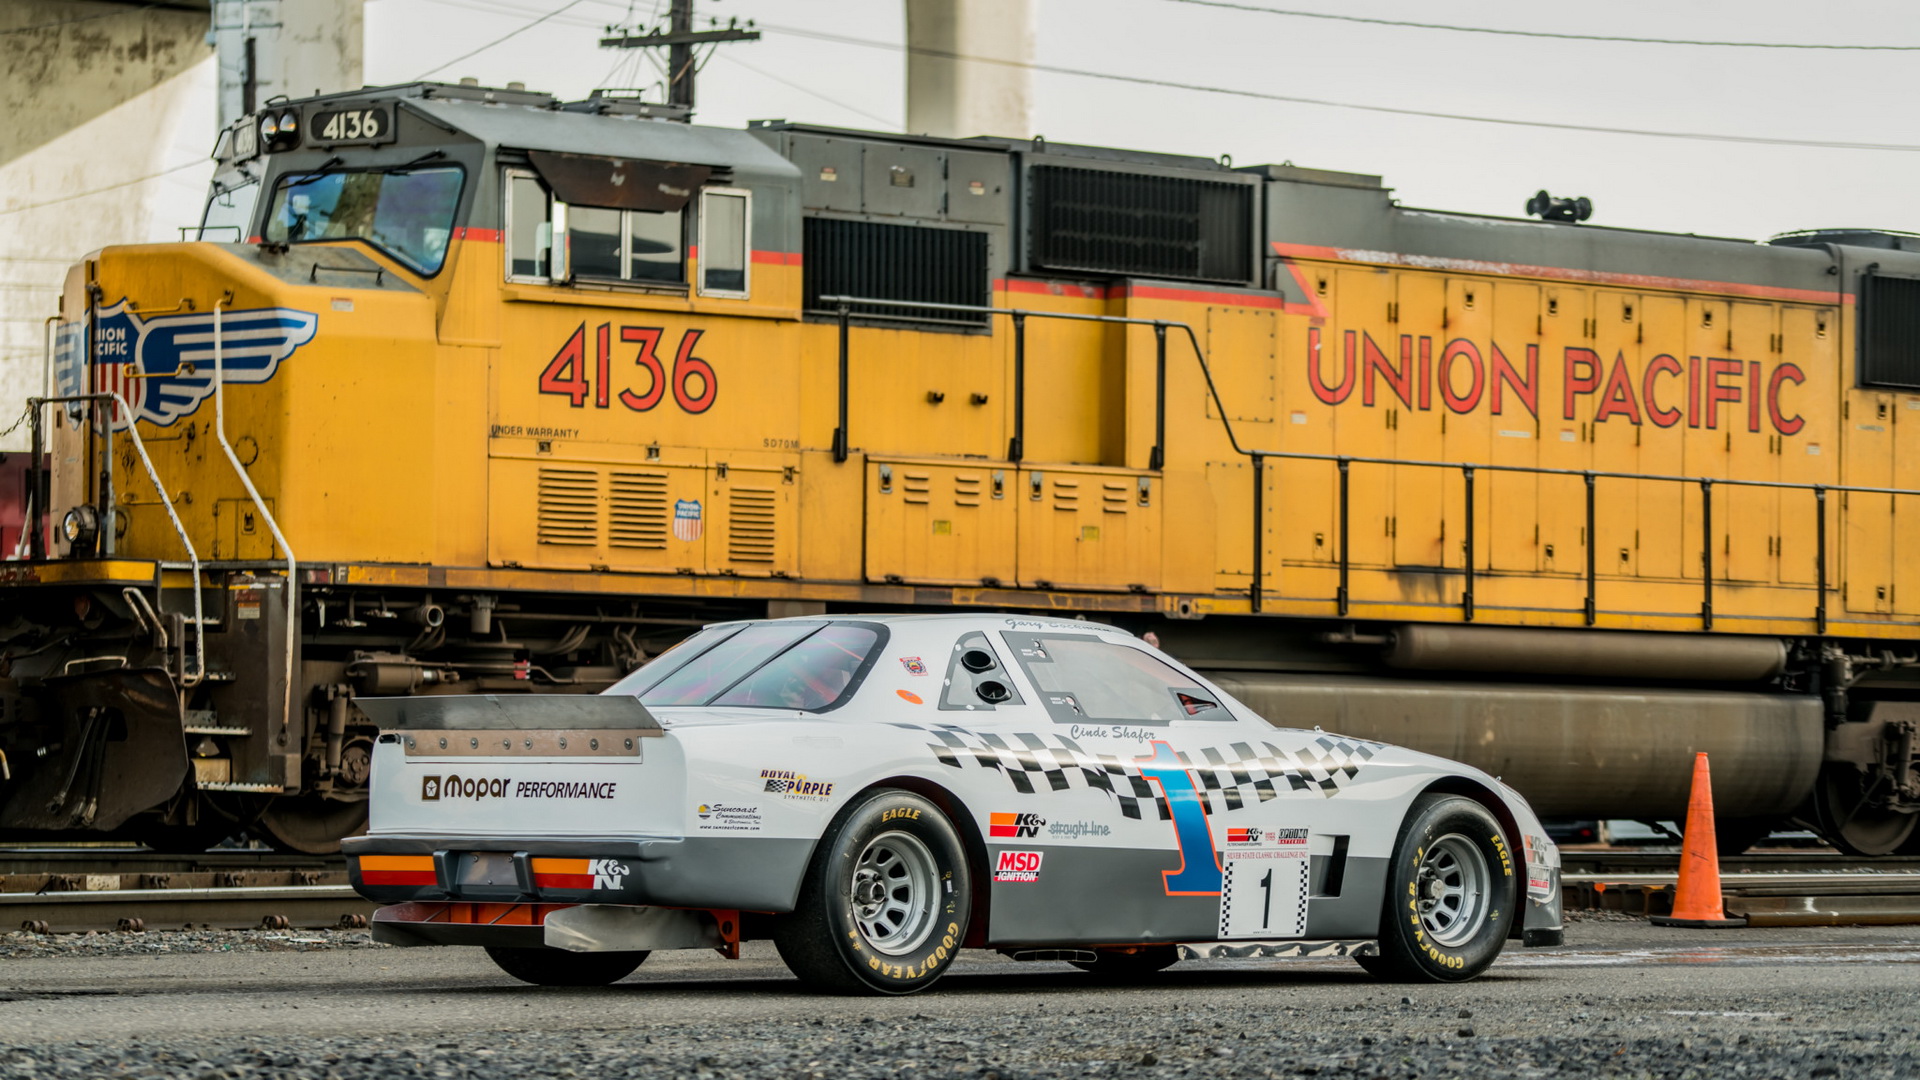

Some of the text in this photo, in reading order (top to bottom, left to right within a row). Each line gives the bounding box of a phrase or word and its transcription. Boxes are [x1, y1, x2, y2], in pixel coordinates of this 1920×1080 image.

[322, 110, 379, 140] 4136
[96, 327, 126, 342] ION
[95, 342, 128, 356] CIFIC
[538, 320, 718, 415] 4136
[1307, 326, 1806, 437] UNION PACIFIC
[491, 424, 580, 439] UNDER WARRANTY
[1070, 724, 1156, 744] Cinde Shafer
[760, 769, 796, 780] ROYAL
[515, 781, 617, 799] PERFORMANCE
[785, 779, 833, 796] PURPLE
[712, 804, 758, 814] Suncoast
[881, 807, 921, 823] EAGLE
[1131, 740, 1223, 897] 1
[998, 852, 1040, 871] MSD
[1490, 834, 1512, 877] EAGLE
[997, 871, 1037, 881] IGNITION
[1260, 868, 1273, 929] 1
[868, 922, 959, 979] GOODYEAR
